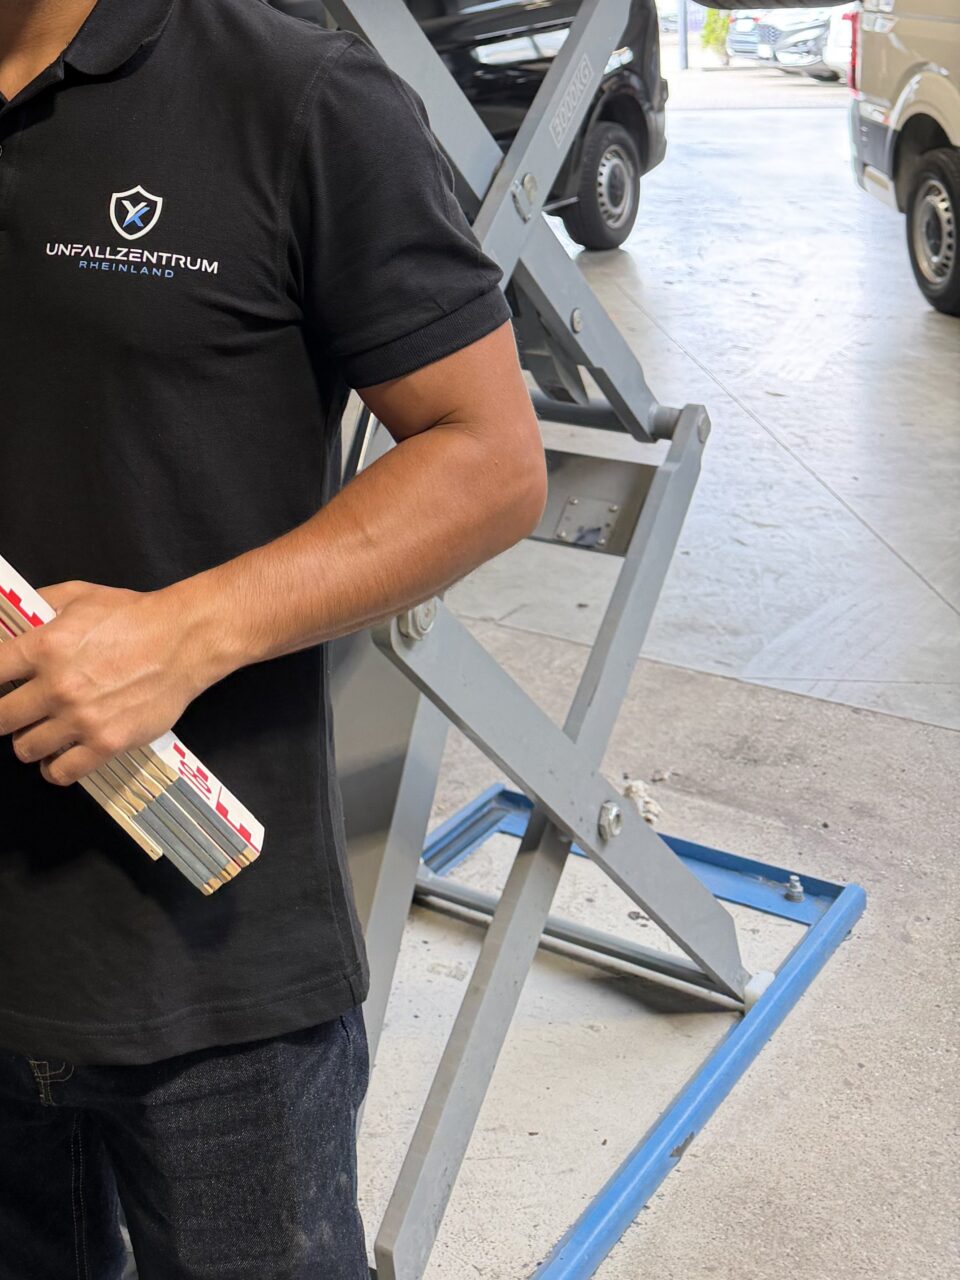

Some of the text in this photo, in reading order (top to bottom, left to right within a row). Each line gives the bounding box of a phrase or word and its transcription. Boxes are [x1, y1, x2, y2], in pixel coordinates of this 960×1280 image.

[46, 243, 219, 274] UNFALLZENTRUM
[78, 260, 175, 278] RHEINLAND
[177, 759, 212, 800] 18
